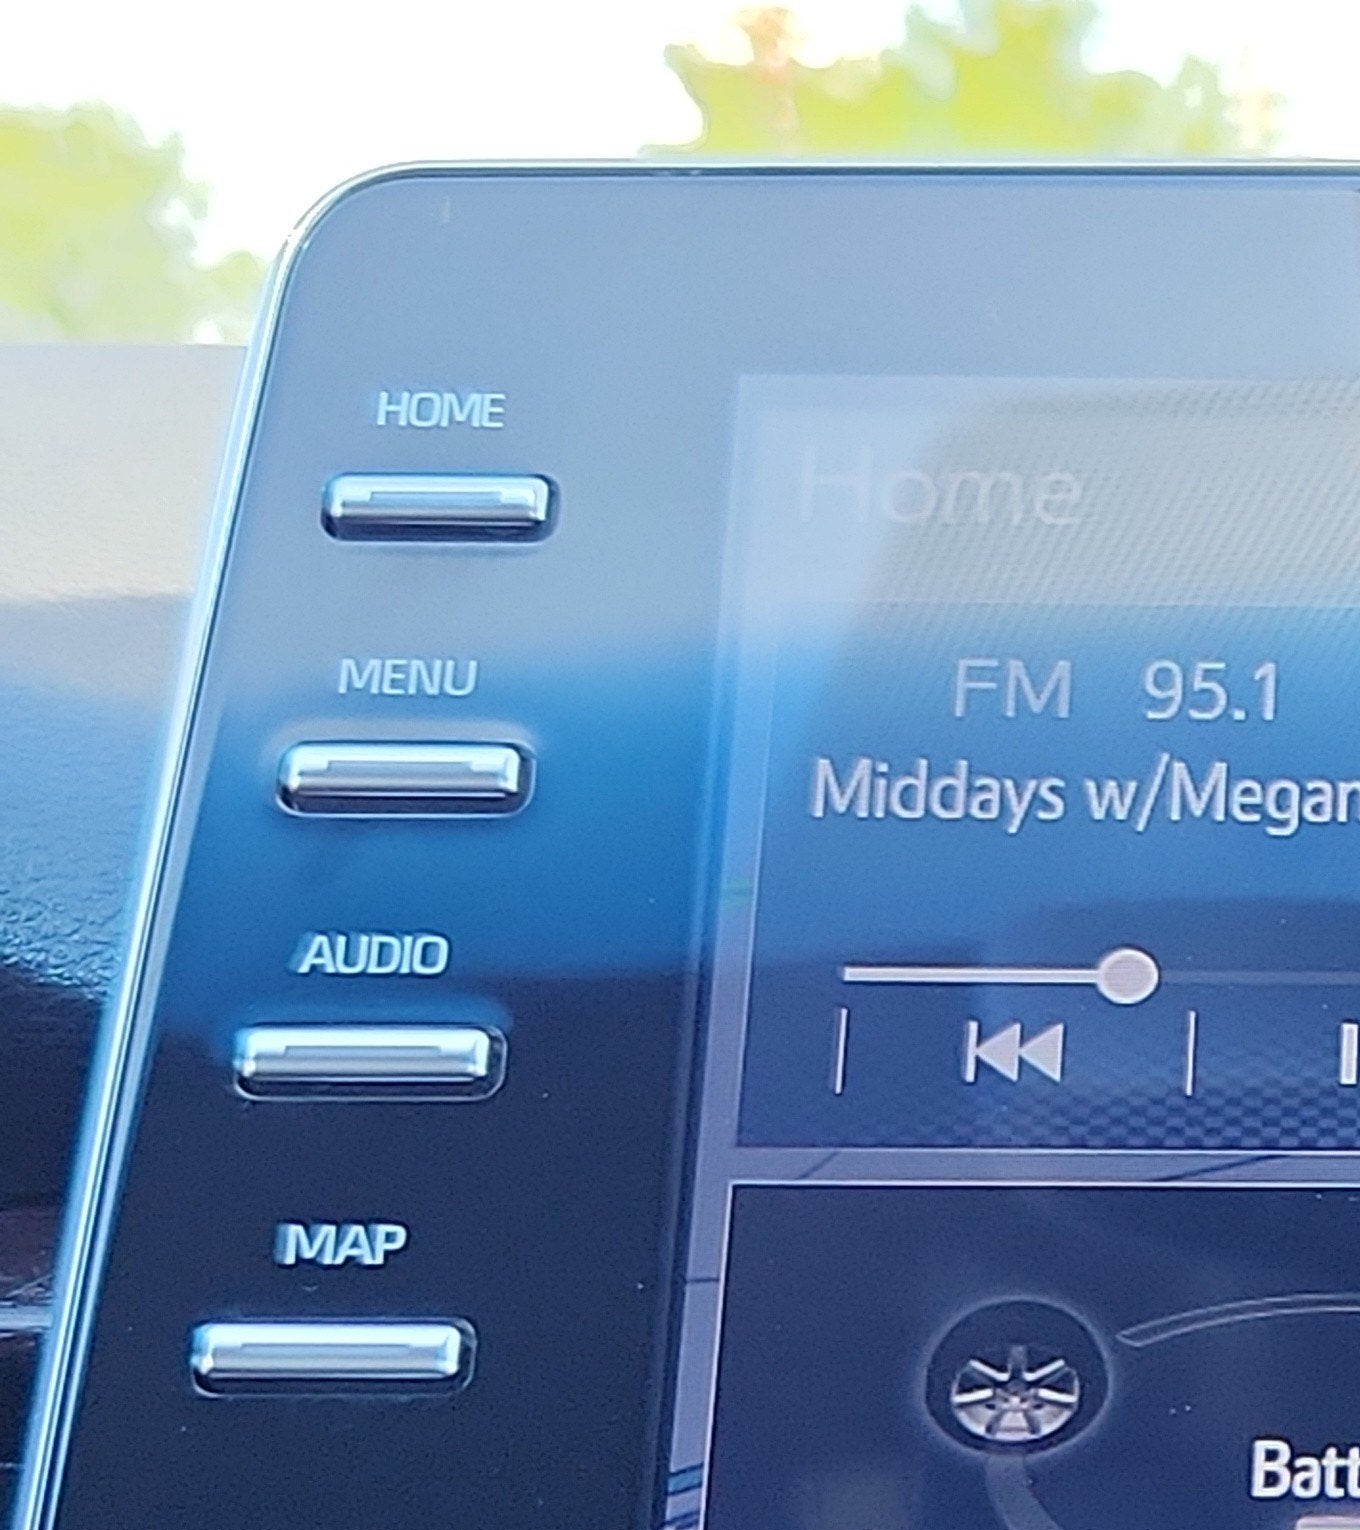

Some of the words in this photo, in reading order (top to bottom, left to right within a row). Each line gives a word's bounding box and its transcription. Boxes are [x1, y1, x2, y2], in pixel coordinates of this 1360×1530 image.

[376, 391, 506, 428] HOME
[801, 446, 1083, 526] Home
[338, 658, 478, 696] MENU
[953, 659, 1072, 719] FM
[1144, 661, 1278, 721] 95.1
[811, 757, 1066, 834] Middays
[294, 933, 450, 976] AUDIO
[277, 1223, 407, 1265] MAP
